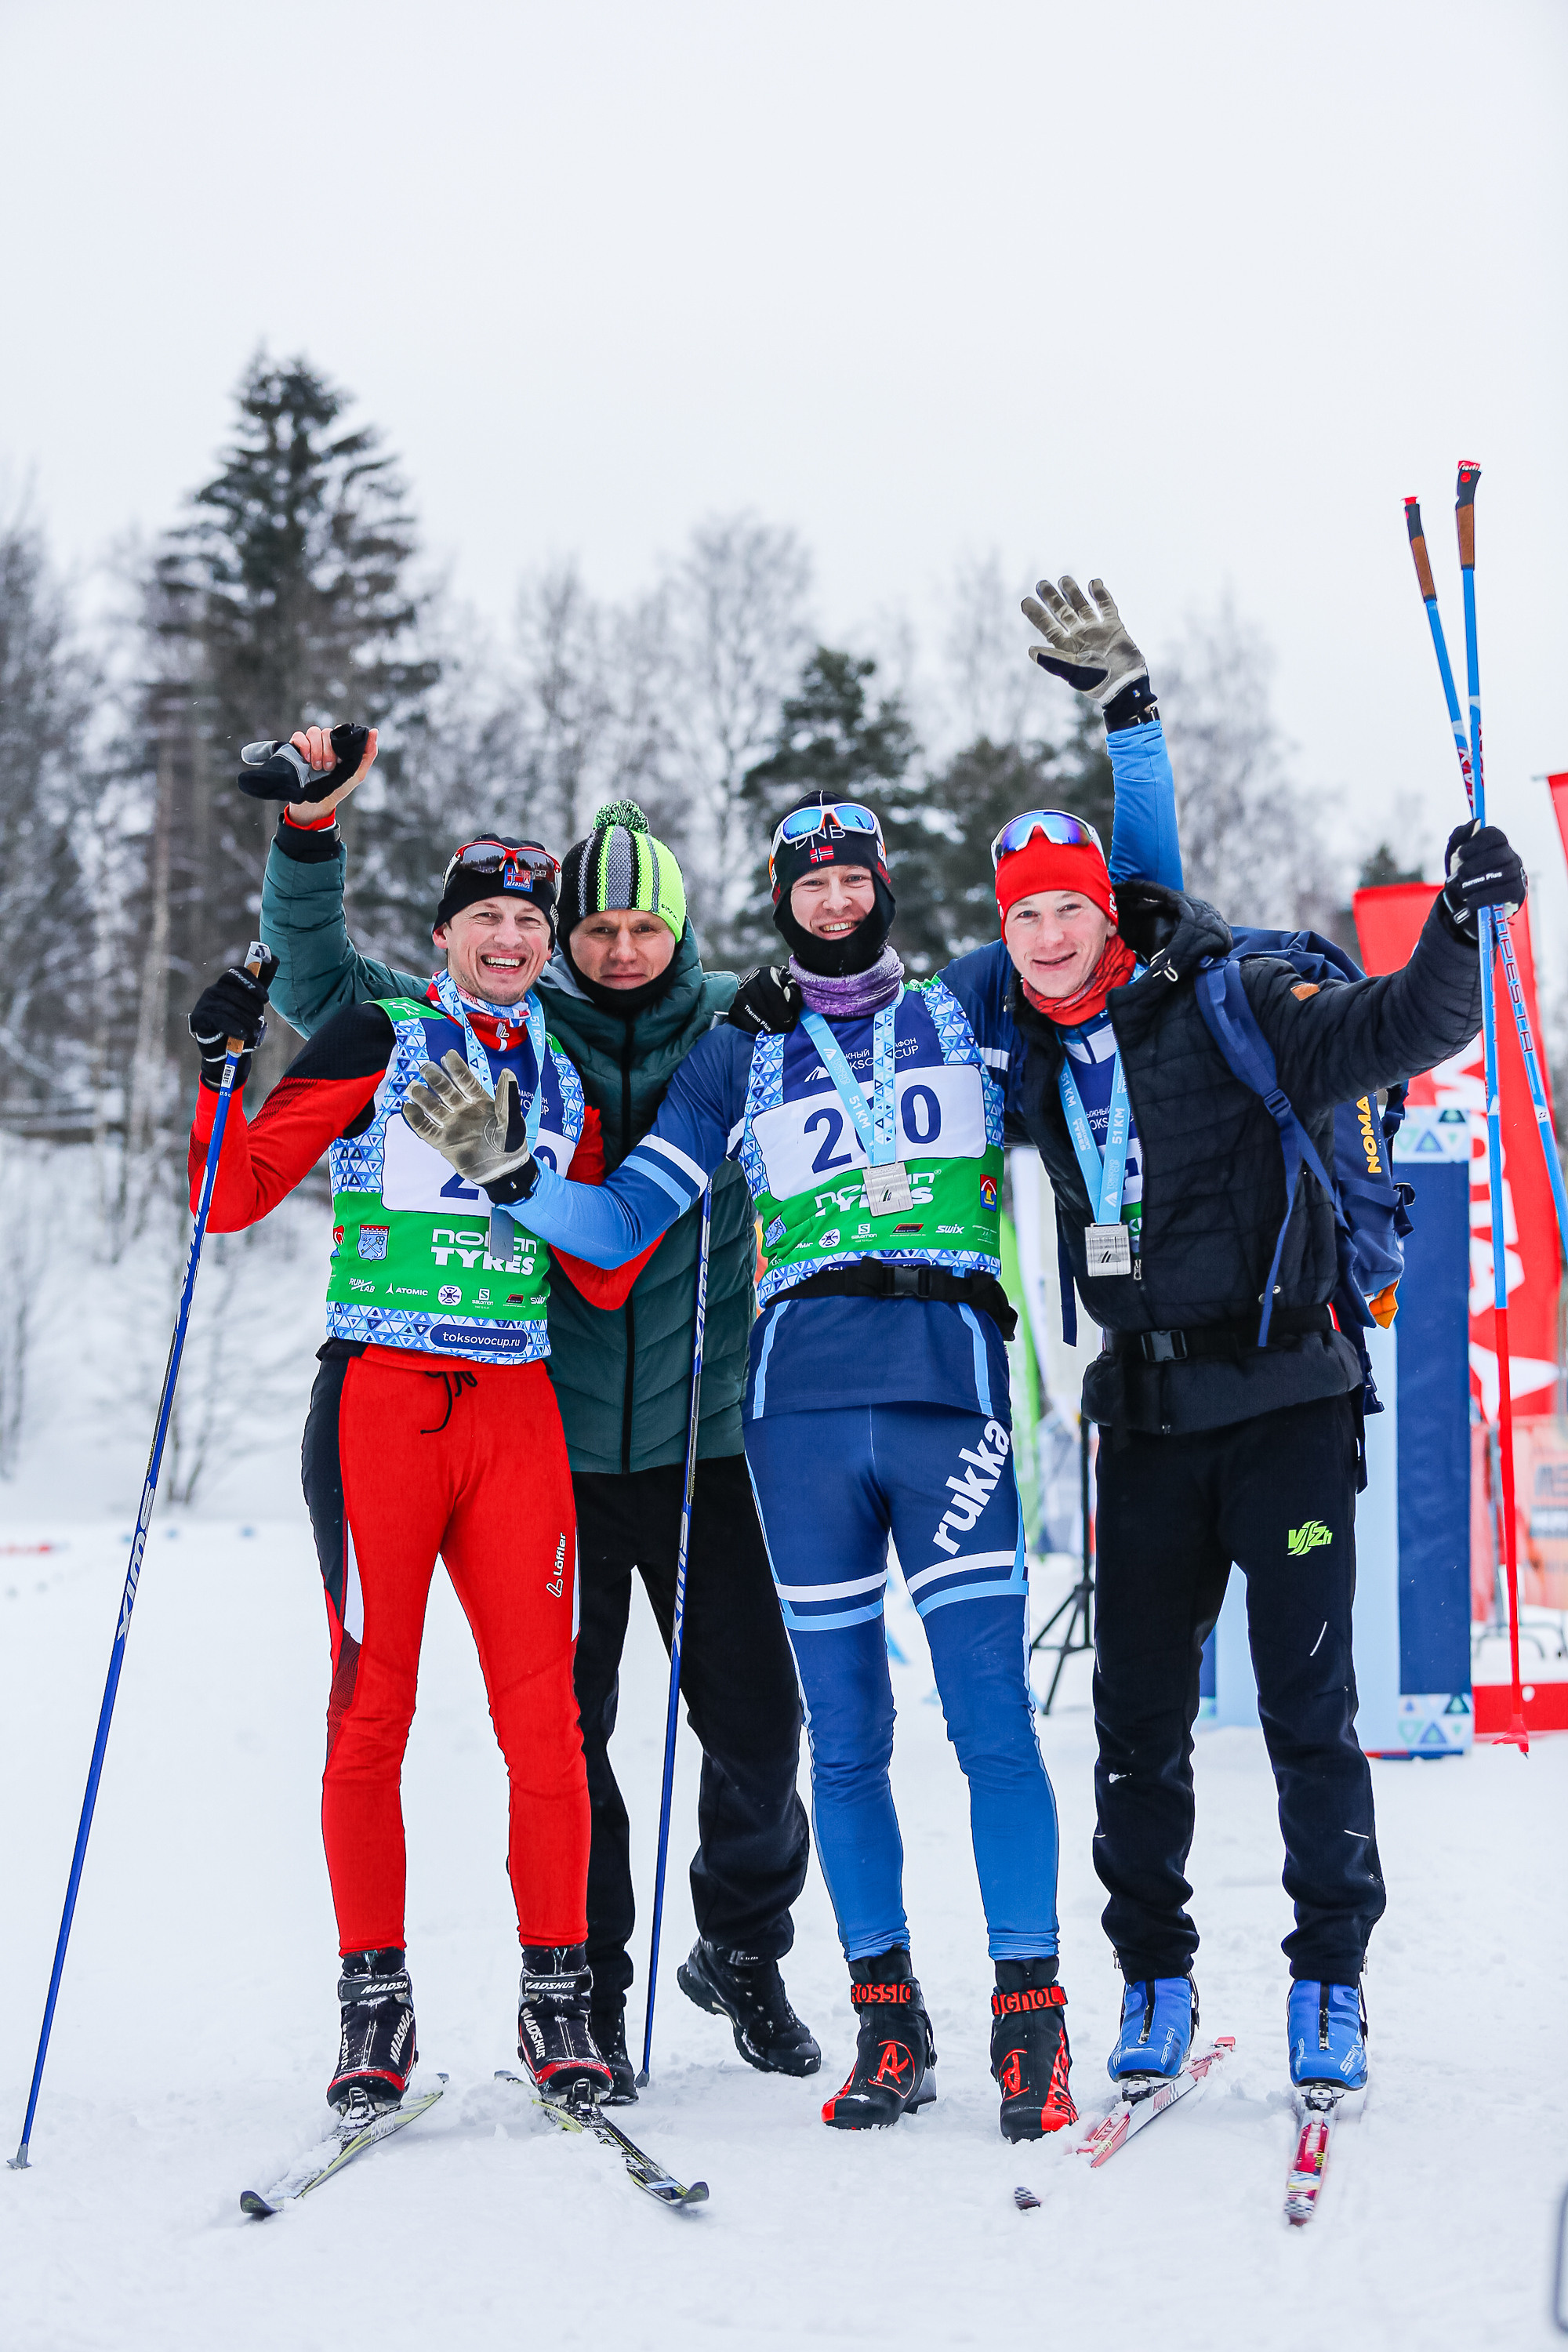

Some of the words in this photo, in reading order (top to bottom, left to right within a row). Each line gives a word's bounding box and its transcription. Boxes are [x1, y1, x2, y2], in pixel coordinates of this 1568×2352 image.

[1486, 871, 1503, 880] Plus
[529, 1015, 541, 1028] 51
[745, 1004, 761, 1022] Thermo
[760, 1020, 771, 1032] Plus
[532, 1028, 543, 1047] KM
[1060, 1072, 1069, 1087] 51
[849, 1094, 863, 1109] 51
[1064, 1087, 1077, 1108] KM
[855, 1109, 871, 1129] KM
[1113, 1107, 1125, 1127] KM
[804, 1084, 942, 1174] 20
[1112, 1129, 1123, 1145] 51
[430, 1245, 537, 1276] TYRES
[349, 1277, 365, 1287] RUN
[360, 1283, 376, 1294] LAB
[395, 1287, 429, 1297] ATOMIC
[442, 1330, 521, 1348] toksovocup.ru
[932, 1419, 1010, 1556] rukka
[553, 1532, 566, 1577] Löffler
